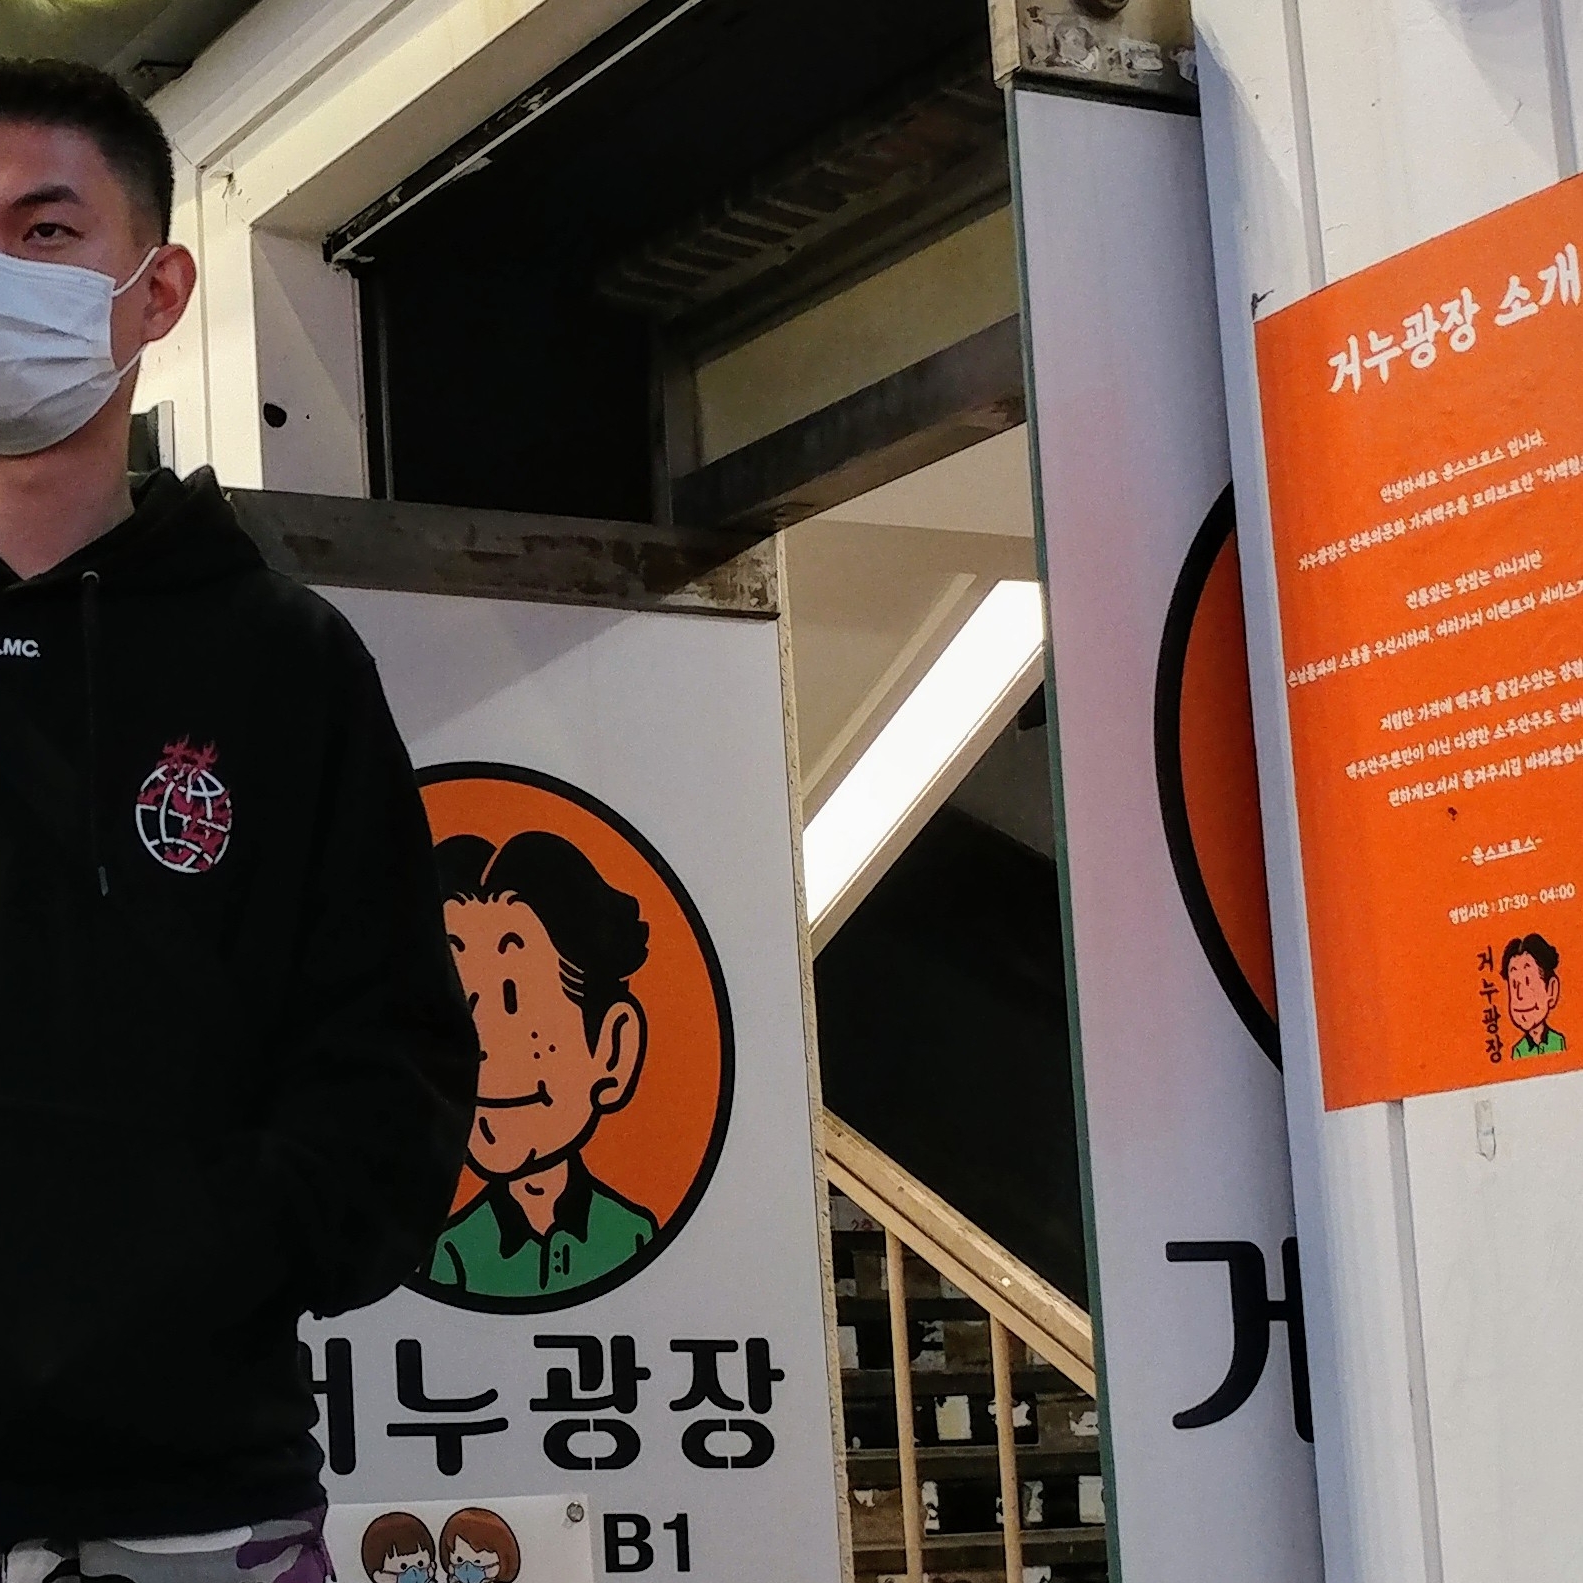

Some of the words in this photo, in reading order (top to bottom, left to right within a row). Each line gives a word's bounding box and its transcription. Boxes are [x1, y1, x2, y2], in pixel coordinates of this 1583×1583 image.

[1328, 286, 1481, 394] 거누광장
[1494, 243, 1581, 327] 소개
[1379, 468, 1440, 503] 안녕하세요
[1448, 900, 1490, 925] 영업시간
[1497, 893, 1529, 914] 17:30
[1539, 882, 1576, 904] 04:00
[1476, 945, 1504, 1063] 거누광장
[603, 1513, 691, 1573] B1
